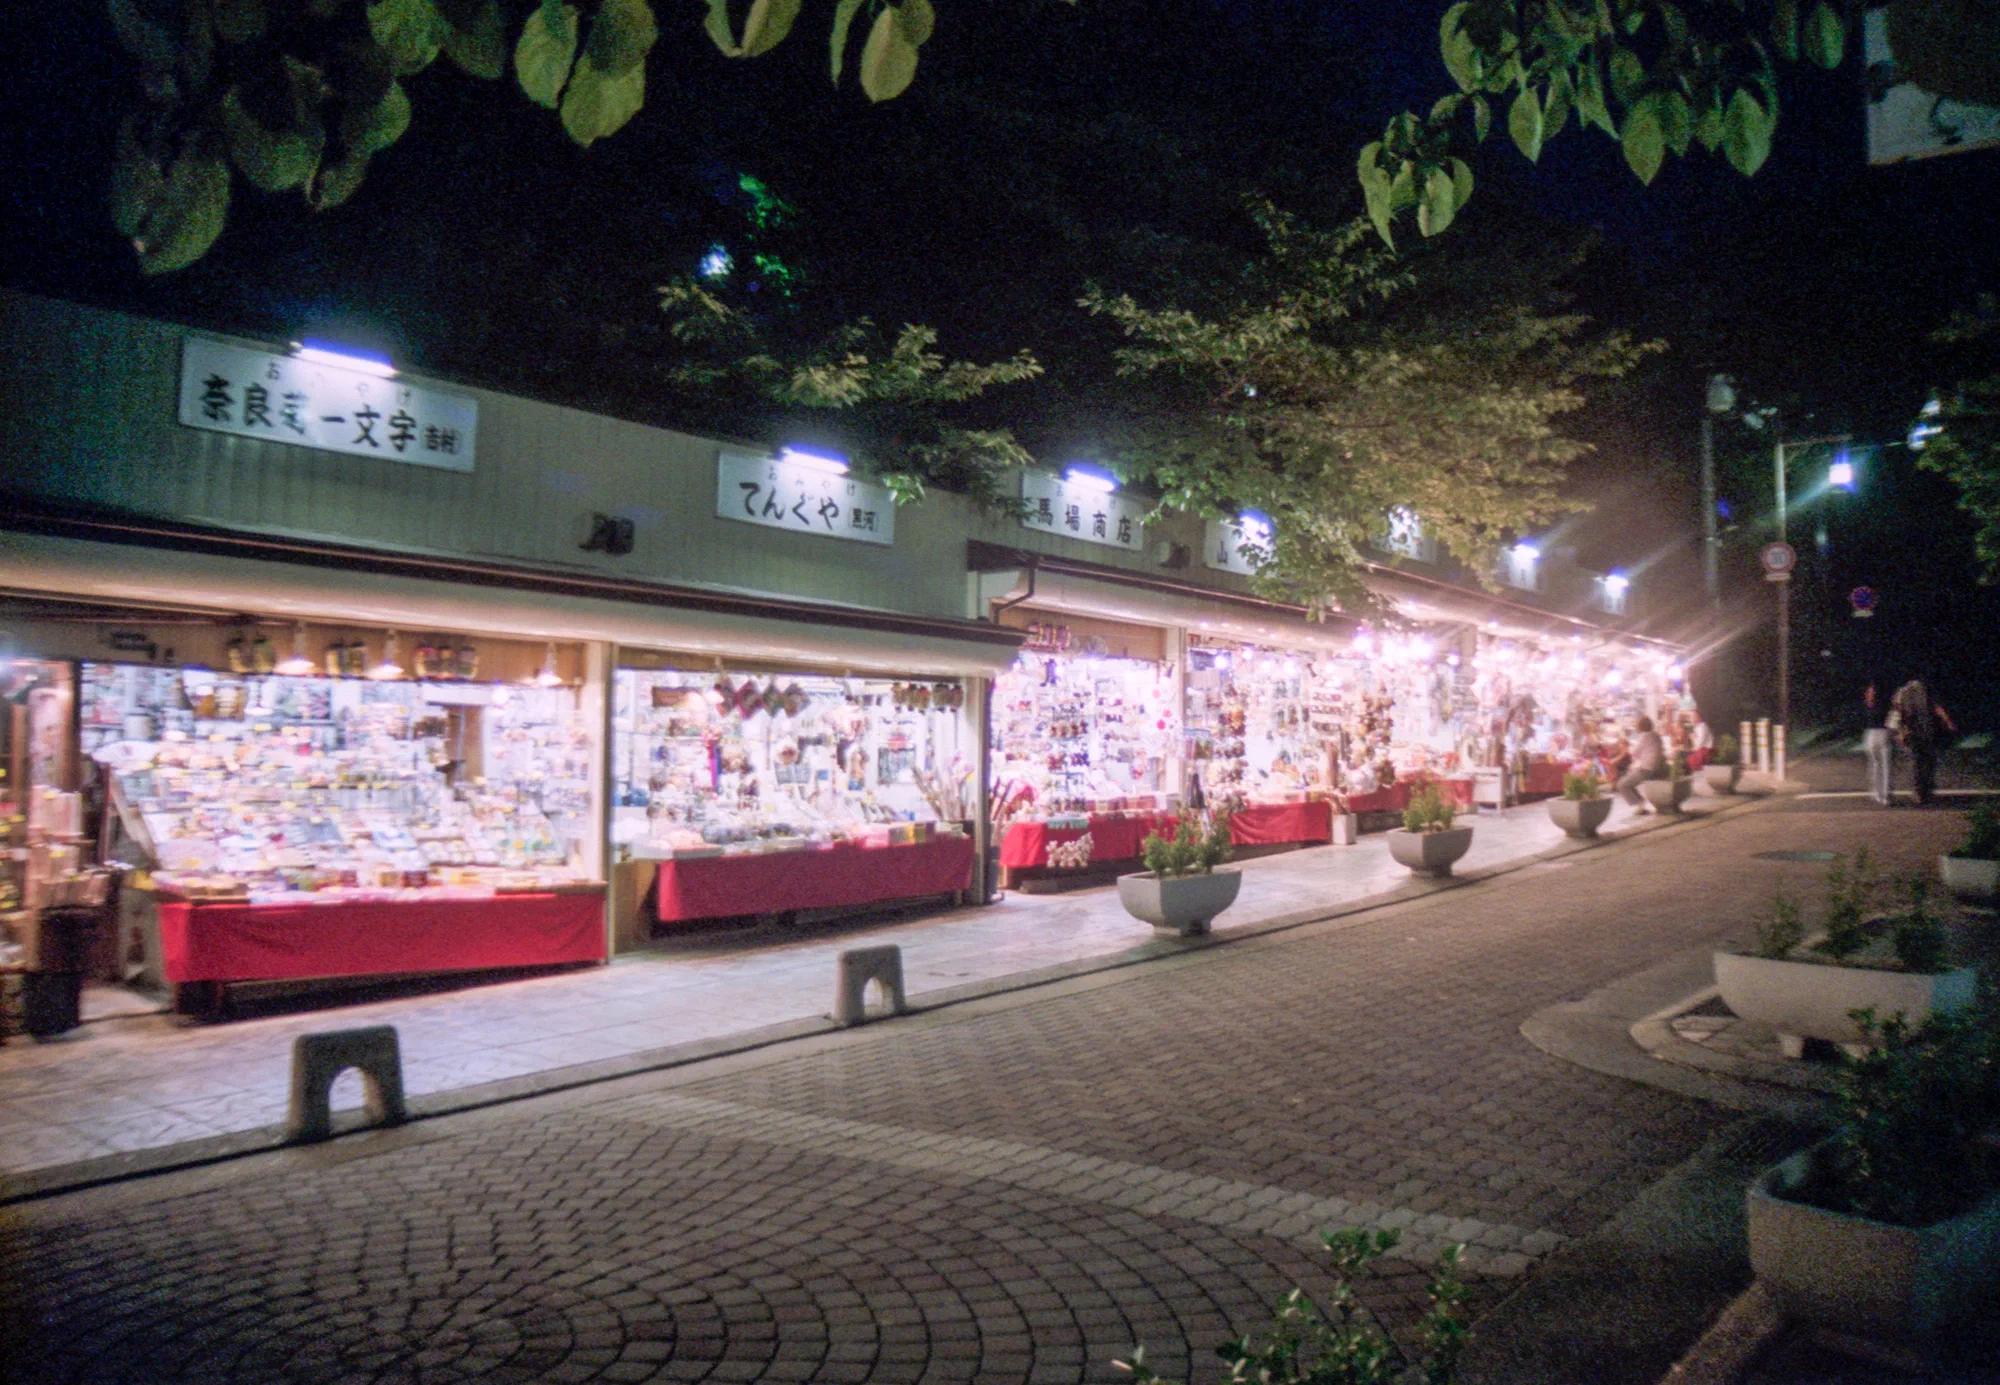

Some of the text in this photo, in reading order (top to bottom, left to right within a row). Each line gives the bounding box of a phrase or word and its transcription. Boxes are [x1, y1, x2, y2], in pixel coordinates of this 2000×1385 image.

[739, 481, 840, 531] てんぐや
[1037, 497, 1131, 544] 馬場商店
